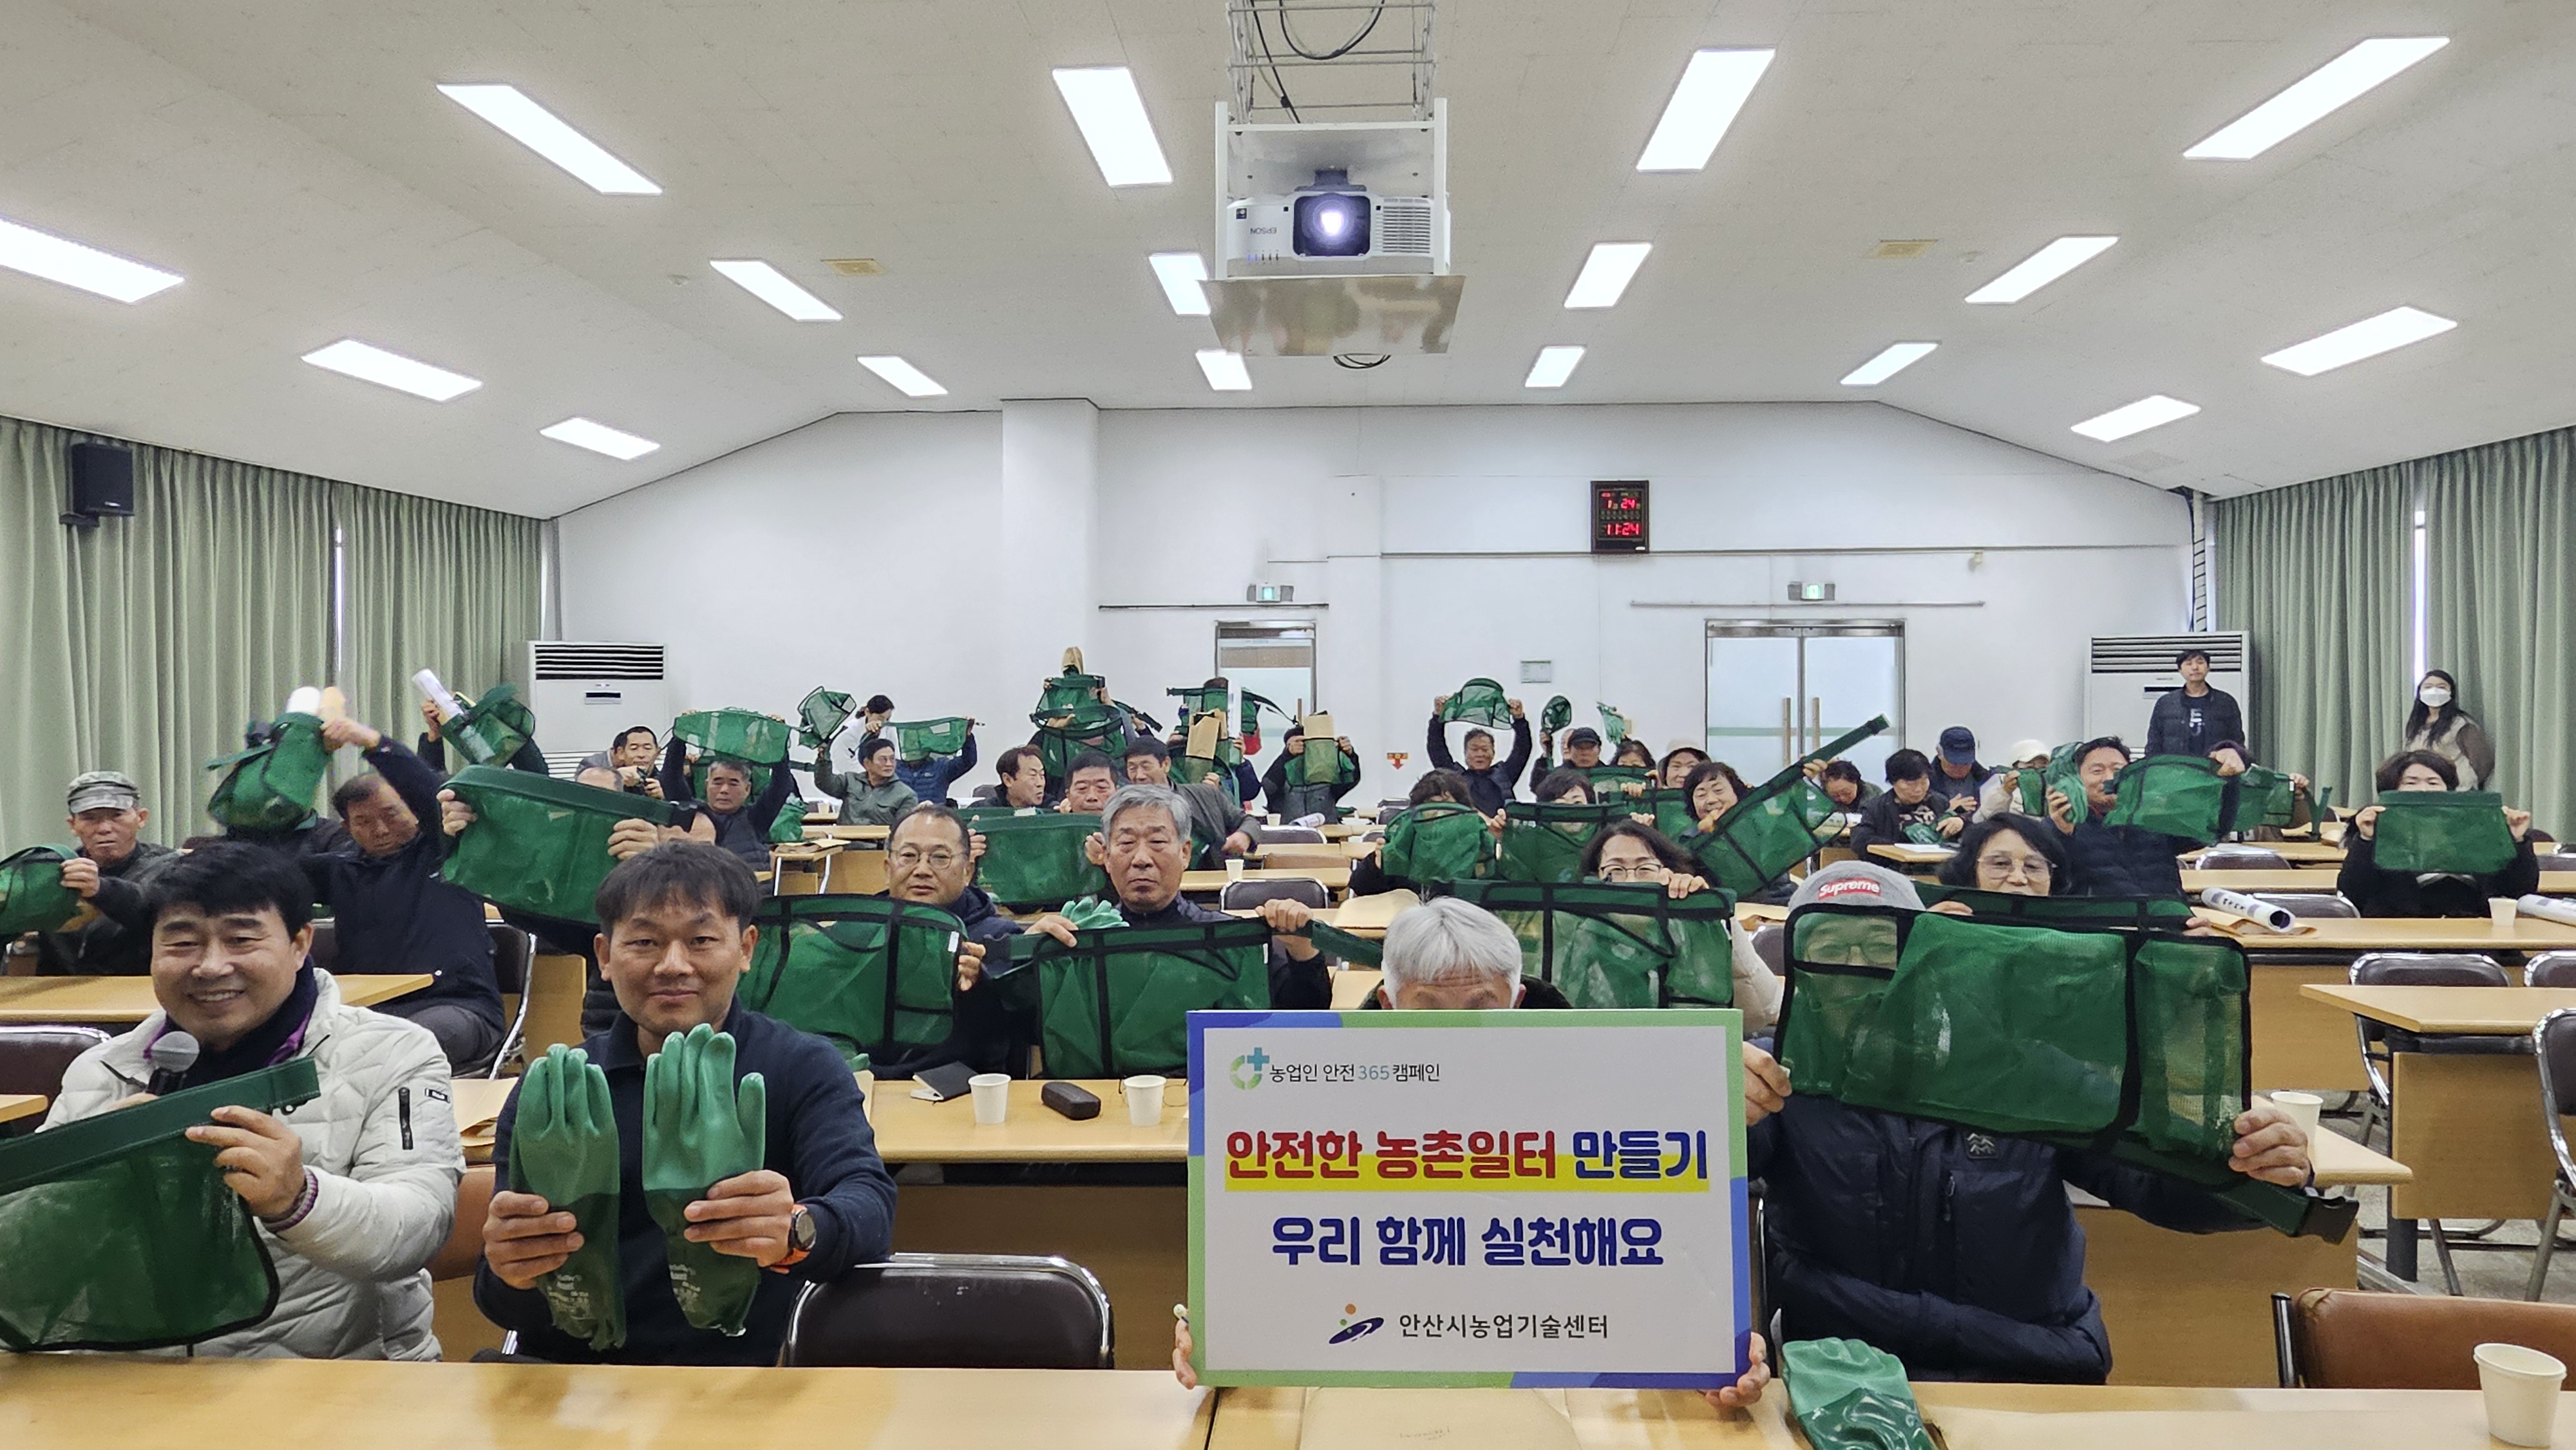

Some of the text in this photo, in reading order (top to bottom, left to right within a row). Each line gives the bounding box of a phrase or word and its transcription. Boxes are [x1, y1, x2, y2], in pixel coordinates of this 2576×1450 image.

[1607, 522, 1640, 536] 11:24
[1819, 880, 1880, 897] Supreme
[1269, 1063, 1440, 1083] 농업인 안전 365 캠페인
[1226, 1130, 1708, 1180] 안전한 농촌일터 만들기
[1272, 1216, 1664, 1266] 우리 함께 실천해요
[1399, 1313, 1608, 1339] 안산시농업기술센터
